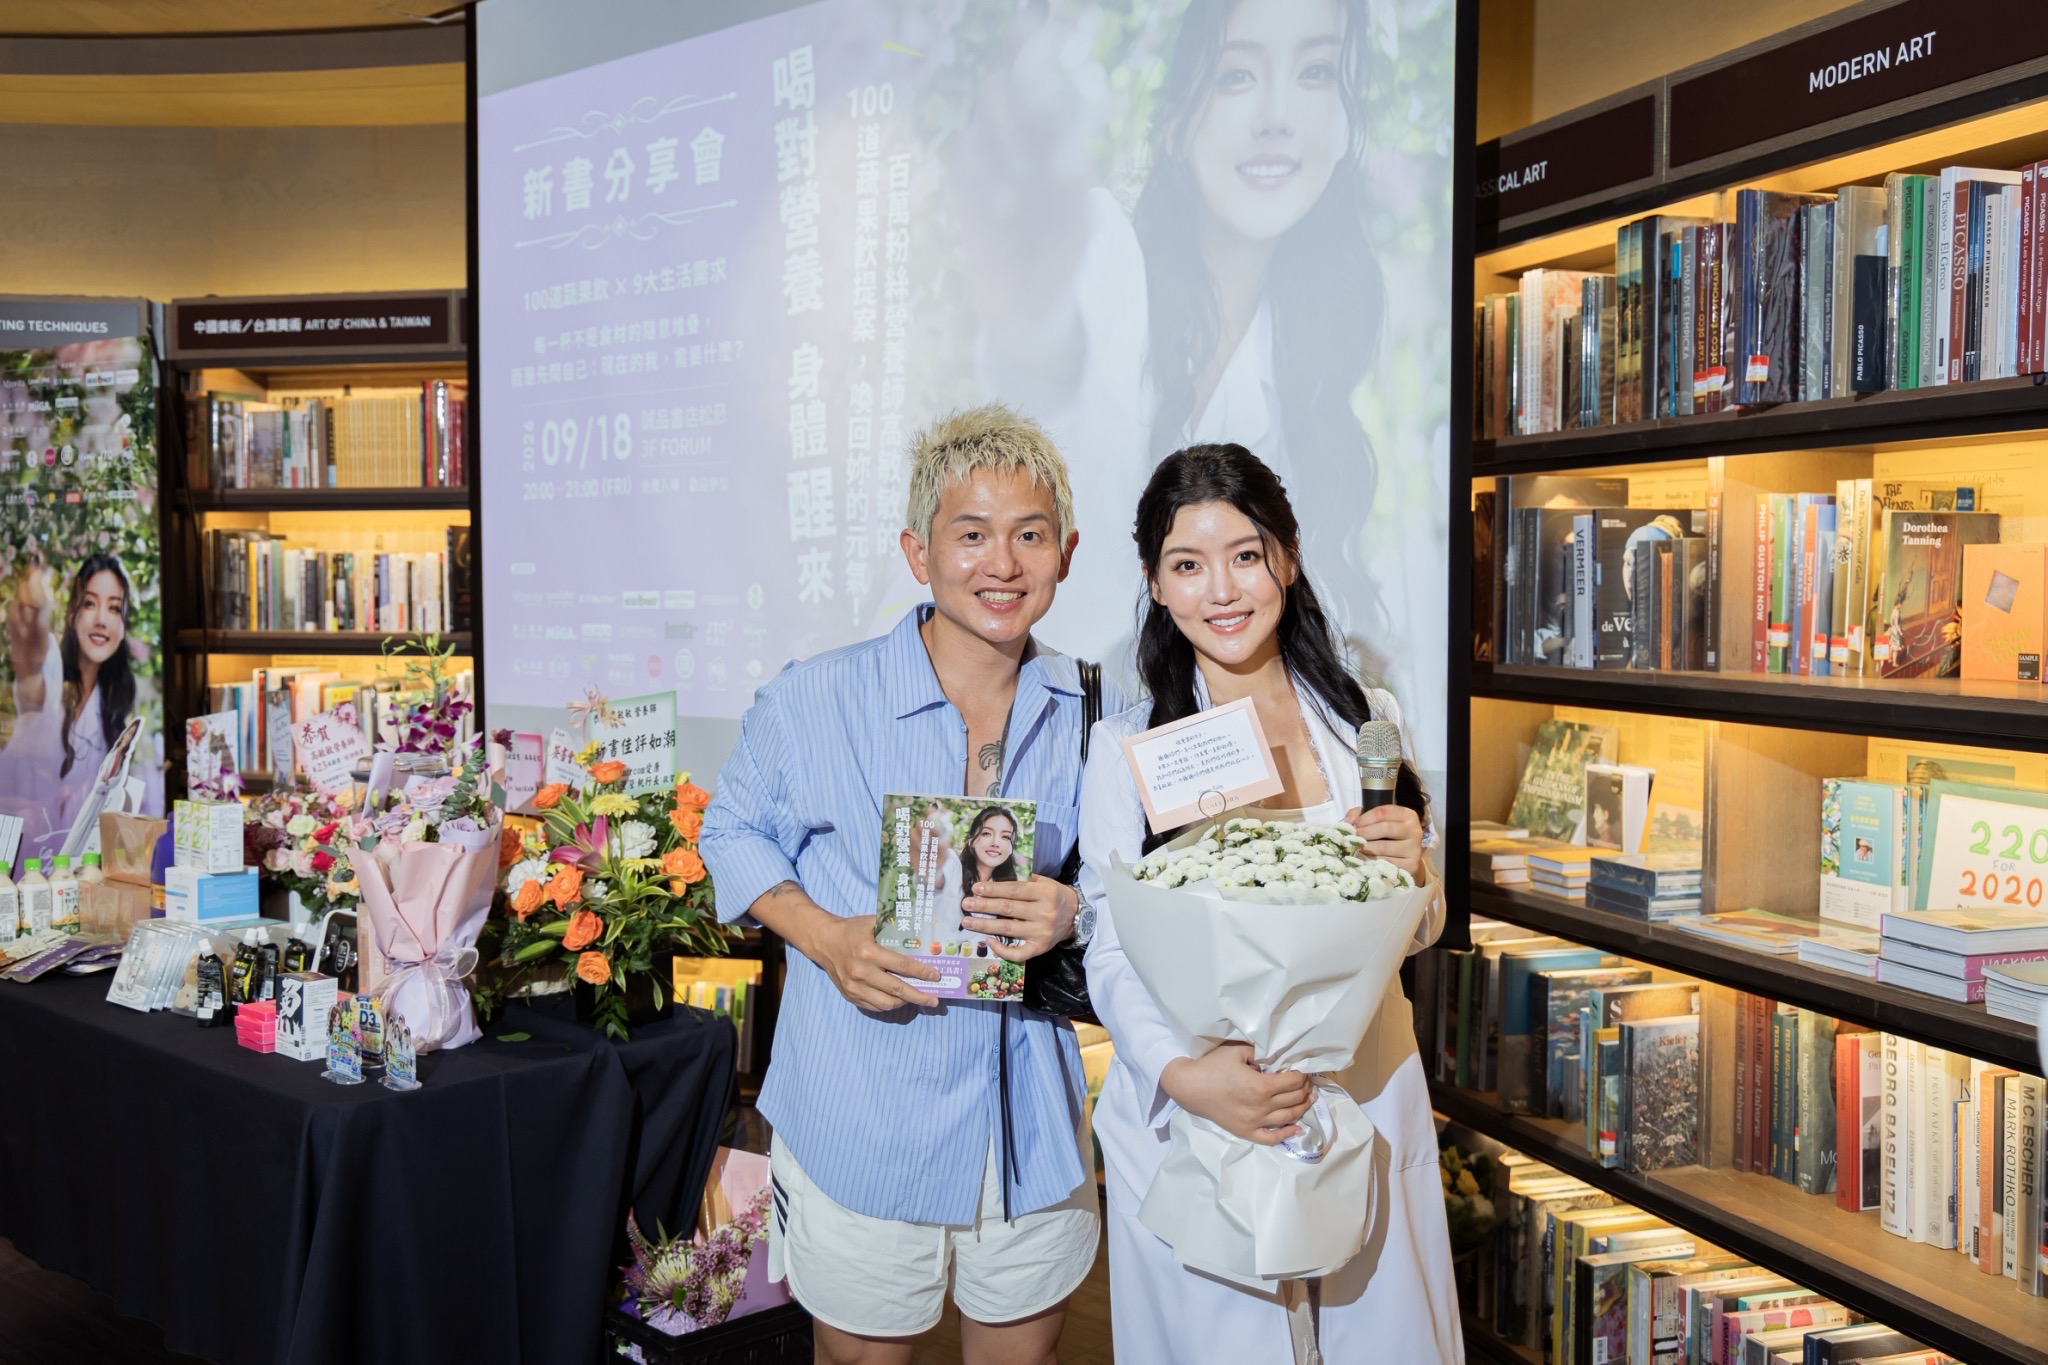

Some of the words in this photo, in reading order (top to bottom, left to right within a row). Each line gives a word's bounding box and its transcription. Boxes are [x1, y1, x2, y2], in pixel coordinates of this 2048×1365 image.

[1809, 47, 1890, 93] MODERN
[1895, 31, 1936, 66] ART
[523, 126, 726, 220] 新書分享會
[773, 45, 825, 316] 喝對營養
[1523, 161, 1548, 185] ART
[1904, 186, 1912, 229] PICASSO
[1941, 191, 1951, 231] Picasso
[1925, 204, 1934, 275] PICASSO/ASIA
[1952, 213, 1966, 290] PICASSO
[522, 277, 609, 312] 100道蔬果飲
[633, 257, 727, 295] 9大生活需求
[1684, 253, 1692, 292] TAMARA
[1939, 256, 1949, 290] Greco
[2020, 291, 2028, 316] d'Alger
[2035, 289, 2043, 313] d'Alger
[27, 319, 109, 333] TECHNIQUES
[304, 318, 326, 330] ART
[327, 318, 342, 330] OF
[343, 317, 377, 329] CHINA
[378, 317, 387, 328] &
[389, 316, 431, 328] TAIWAN
[1682, 311, 1691, 360] LEMPICKA
[1922, 286, 1931, 365] CONVERSATION
[1901, 331, 1909, 383] GAGOSIAN
[541, 412, 633, 471] 09/18
[640, 440, 657, 458] 3F
[661, 436, 712, 457] FORUM
[602, 475, 632, 497] (FRI)
[786, 342, 837, 604] 身體醒來
[1884, 484, 1902, 498] THE
[1759, 504, 1767, 542] PHILIP
[1902, 535, 1942, 548] Tanning
[1903, 522, 1948, 534] Dorothea
[1575, 529, 1585, 596] VERMEER
[1757, 545, 1765, 591] GUSTON
[1601, 621, 1613, 632] de
[302, 723, 330, 744] 恭賀
[896, 807, 911, 867] 喝對營養
[1969, 820, 2048, 865] 220
[1993, 859, 2016, 872] FOR
[895, 873, 912, 931] 身體醒來
[1959, 870, 2043, 907] 2020
[360, 1010, 376, 1026] D3
[1659, 1034, 1687, 1046] Kiefer
[1755, 1027, 1763, 1060] Kahlo
[1886, 1034, 1897, 1107] GEORG
[1736, 1086, 1744, 1133] Universe
[1931, 1076, 1939, 1107] FRANZ
[2023, 1085, 2035, 1120] M.C.
[1754, 1088, 1762, 1137] Universe
[1931, 1112, 1939, 1144] KAFKA
[2006, 1098, 2016, 1140] MARK
[1885, 1112, 1897, 1214] BASELITZ
[2005, 1145, 2016, 1207] ROTHKO
[2022, 1125, 2035, 1196] ESCHER
